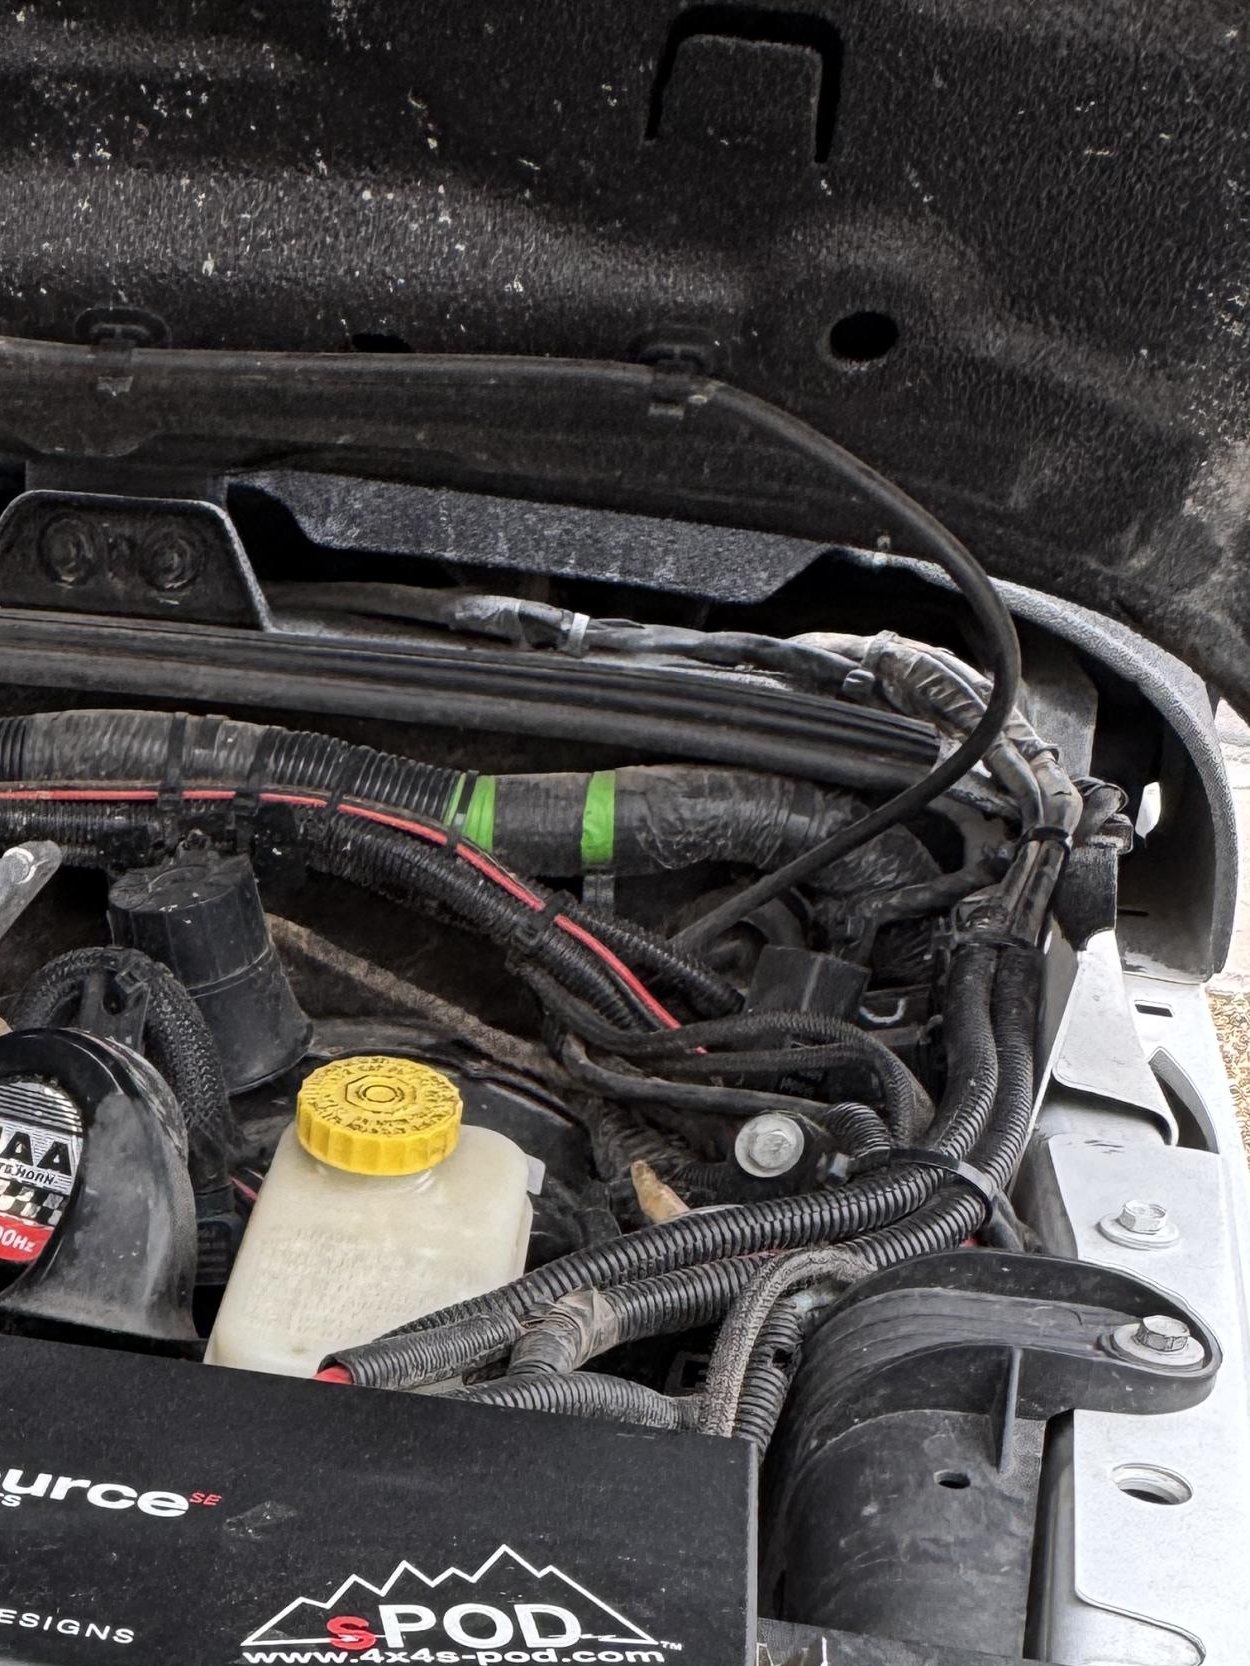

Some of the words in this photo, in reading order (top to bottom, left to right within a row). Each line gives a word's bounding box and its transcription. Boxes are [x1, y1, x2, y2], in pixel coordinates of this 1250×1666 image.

[15, 1164, 55, 1186] HORN
[326, 1602, 582, 1650] sPOD
[242, 1647, 665, 1666] www.4x4s-pod.com
